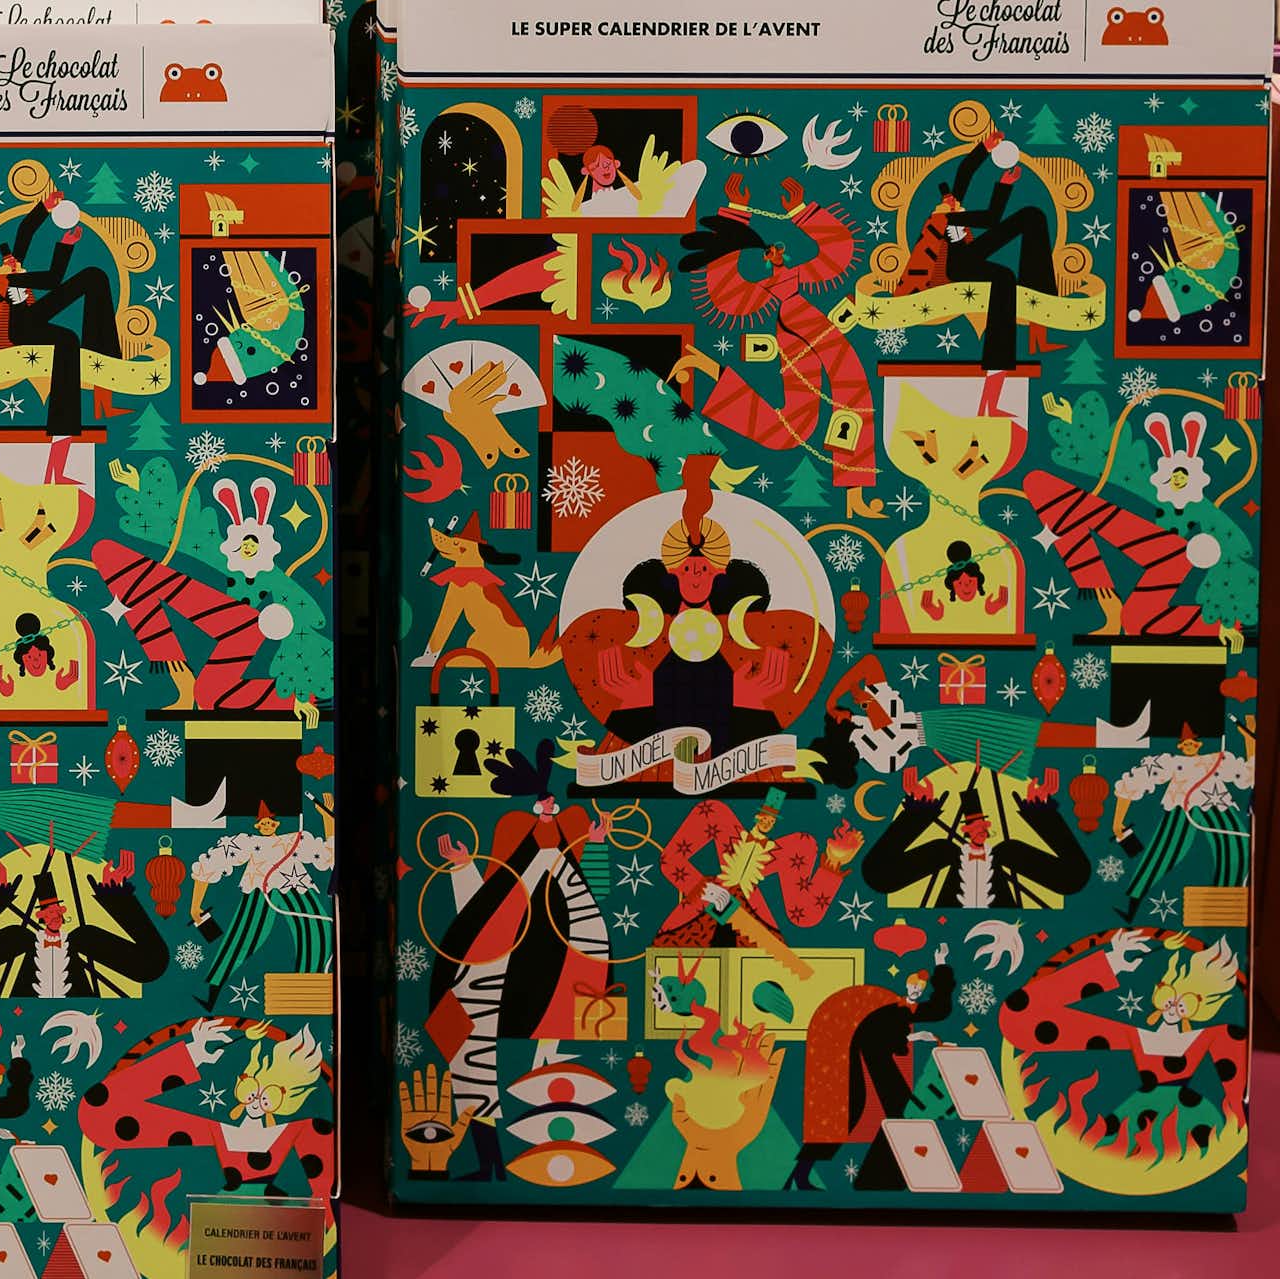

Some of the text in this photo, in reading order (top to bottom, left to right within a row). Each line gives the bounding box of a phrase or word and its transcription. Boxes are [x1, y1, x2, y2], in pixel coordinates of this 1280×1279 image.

[512, 22, 820, 36] LE SUPER CALENDRIER DE L'AVENT
[924, 24, 1071, 62] des Français
[36, 49, 119, 80] chocolat
[20, 80, 128, 120] Français
[600, 754, 626, 782] UN
[631, 734, 672, 772] NOËL
[204, 1227, 312, 1242] CALENDRIER DE L'AVENT
[197, 1254, 317, 1272] LE CHOCOLAT DES FRANÇAIS
